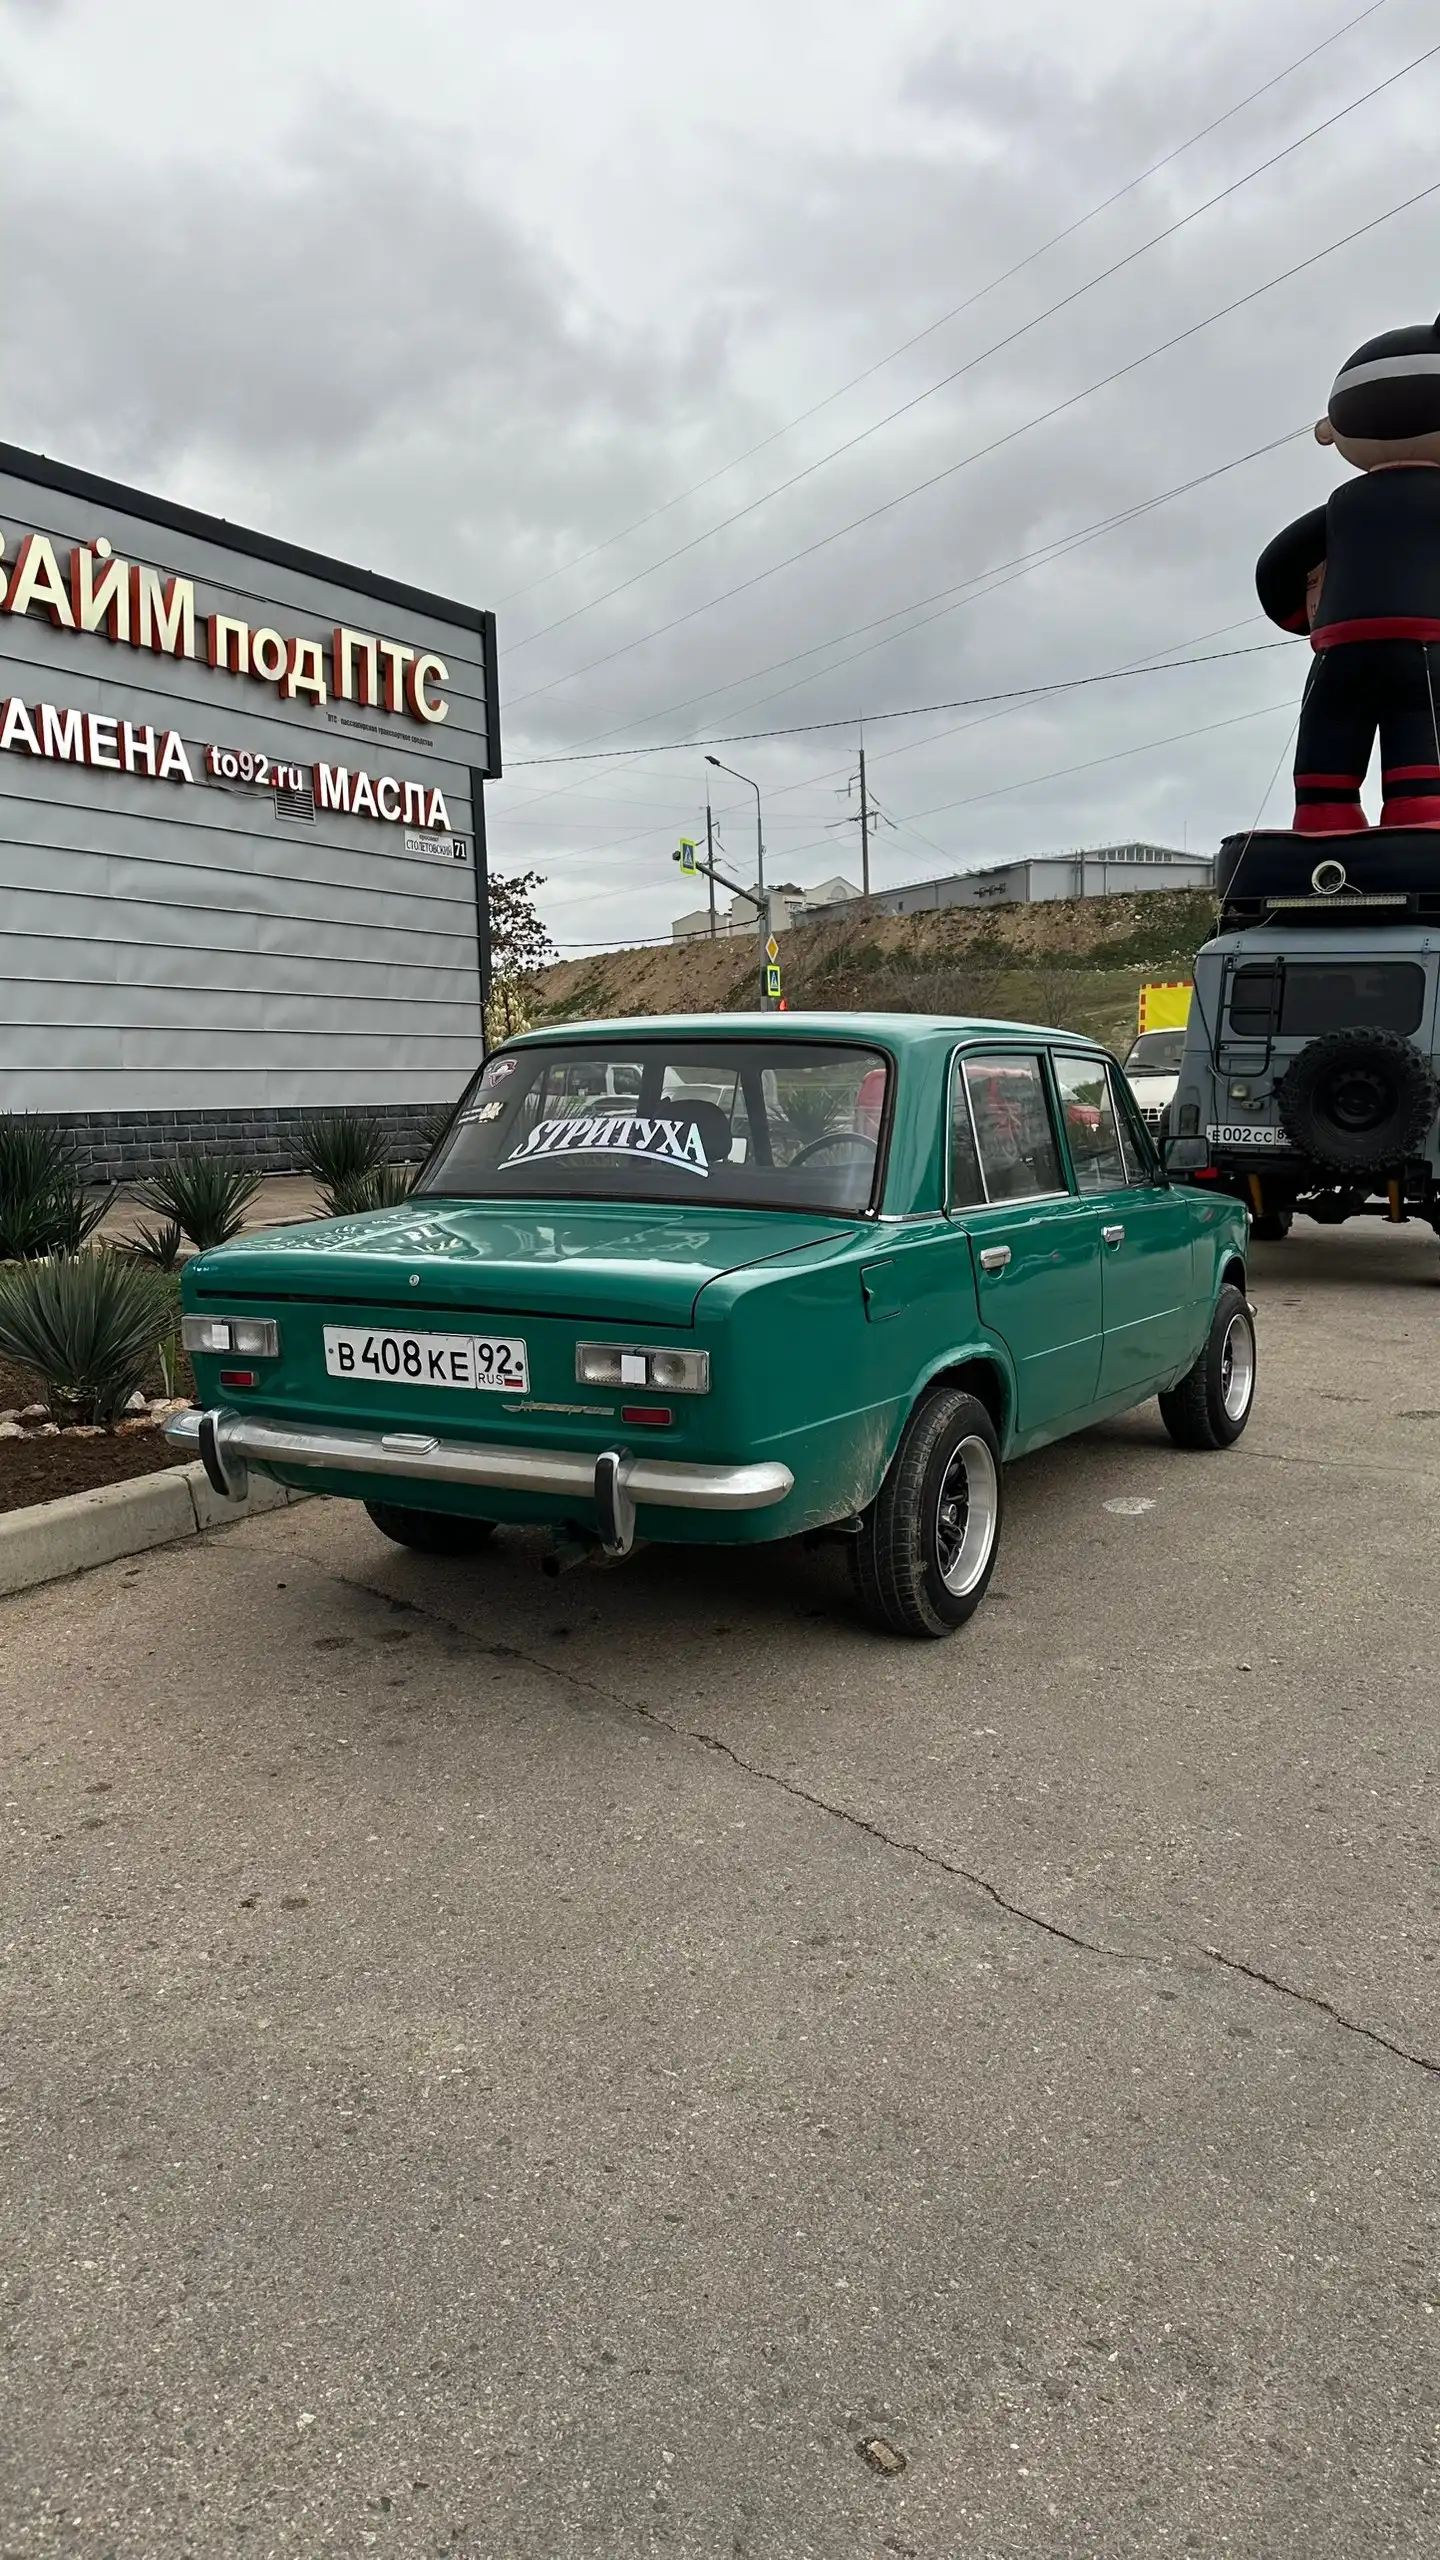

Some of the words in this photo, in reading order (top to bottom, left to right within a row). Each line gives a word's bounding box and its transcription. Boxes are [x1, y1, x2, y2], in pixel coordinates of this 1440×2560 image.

[0, 532, 195, 658] АЙМ
[215, 615, 327, 705] под
[340, 627, 450, 723] ПТС
[211, 746, 303, 791] to92.ru
[318, 762, 452, 831] МАСЛА
[454, 842, 467, 857] 71
[337, 1336, 470, 1382] В408КЕ
[478, 1343, 513, 1374] 92
[478, 1373, 504, 1385] RUS
